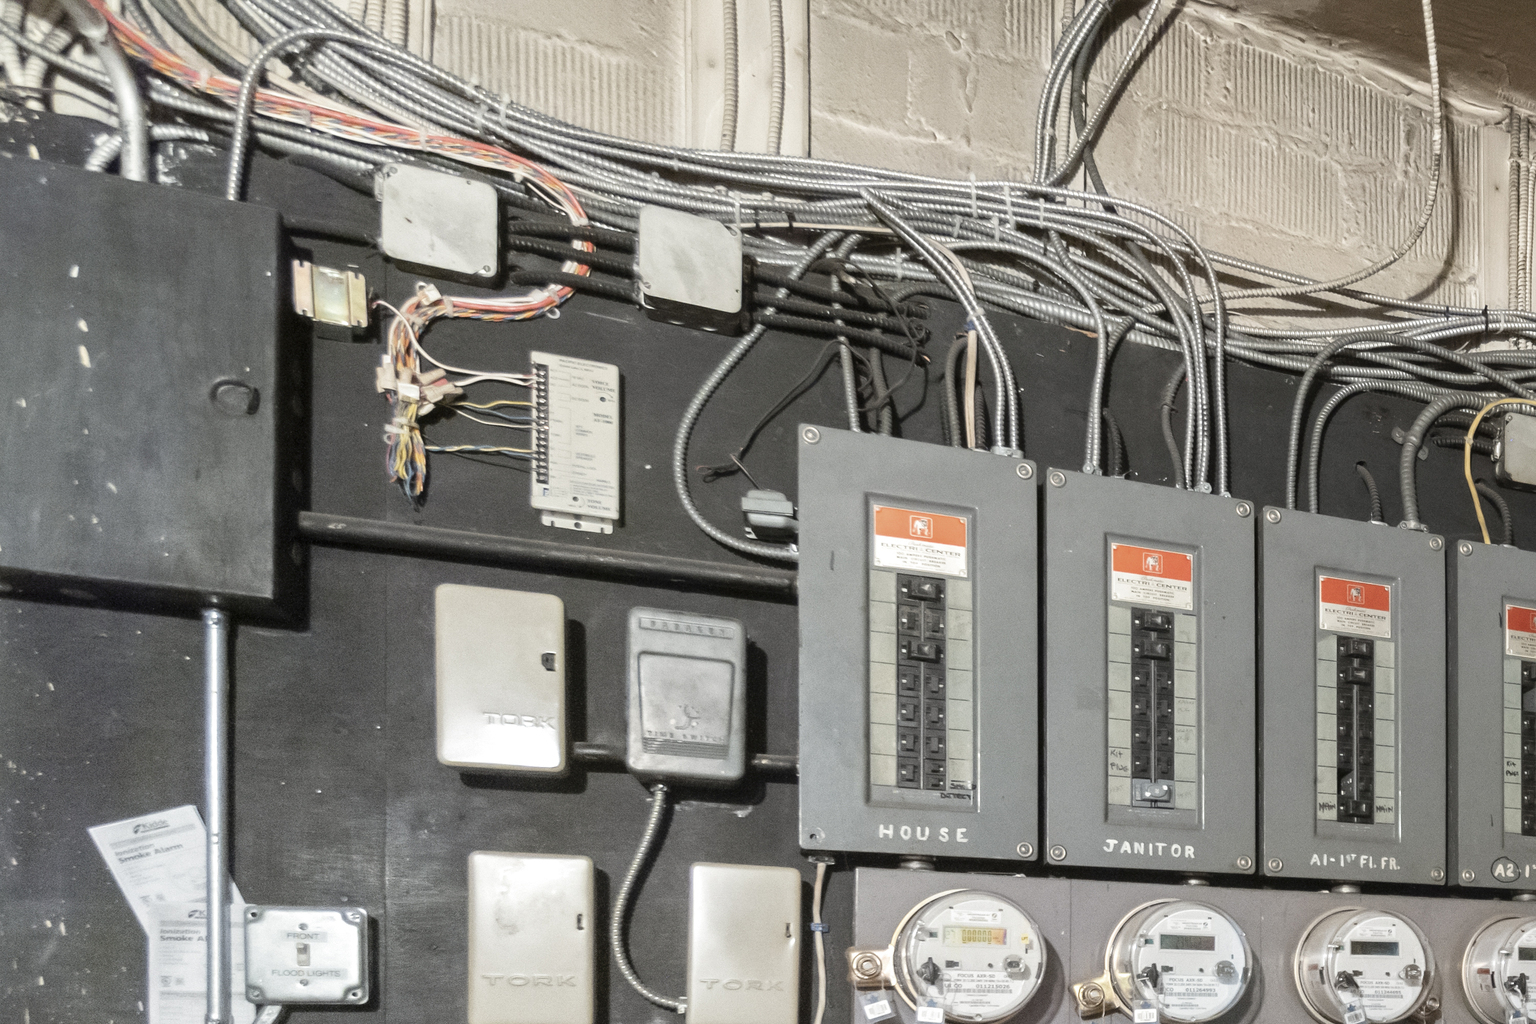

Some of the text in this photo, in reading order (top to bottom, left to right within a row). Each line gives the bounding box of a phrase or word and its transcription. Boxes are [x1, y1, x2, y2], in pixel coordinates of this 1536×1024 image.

[483, 711, 556, 730] TORK
[879, 824, 969, 843] HOUSE
[114, 843, 155, 856] Ionization
[118, 843, 183, 864] Smoke Alarm
[1103, 838, 1195, 859] JANITOR
[160, 928, 201, 936] Ionization
[286, 932, 320, 941] FRONT
[271, 969, 341, 978] FLOOD LIGHTS
[482, 973, 577, 988] TORK
[699, 978, 784, 992] TORK
